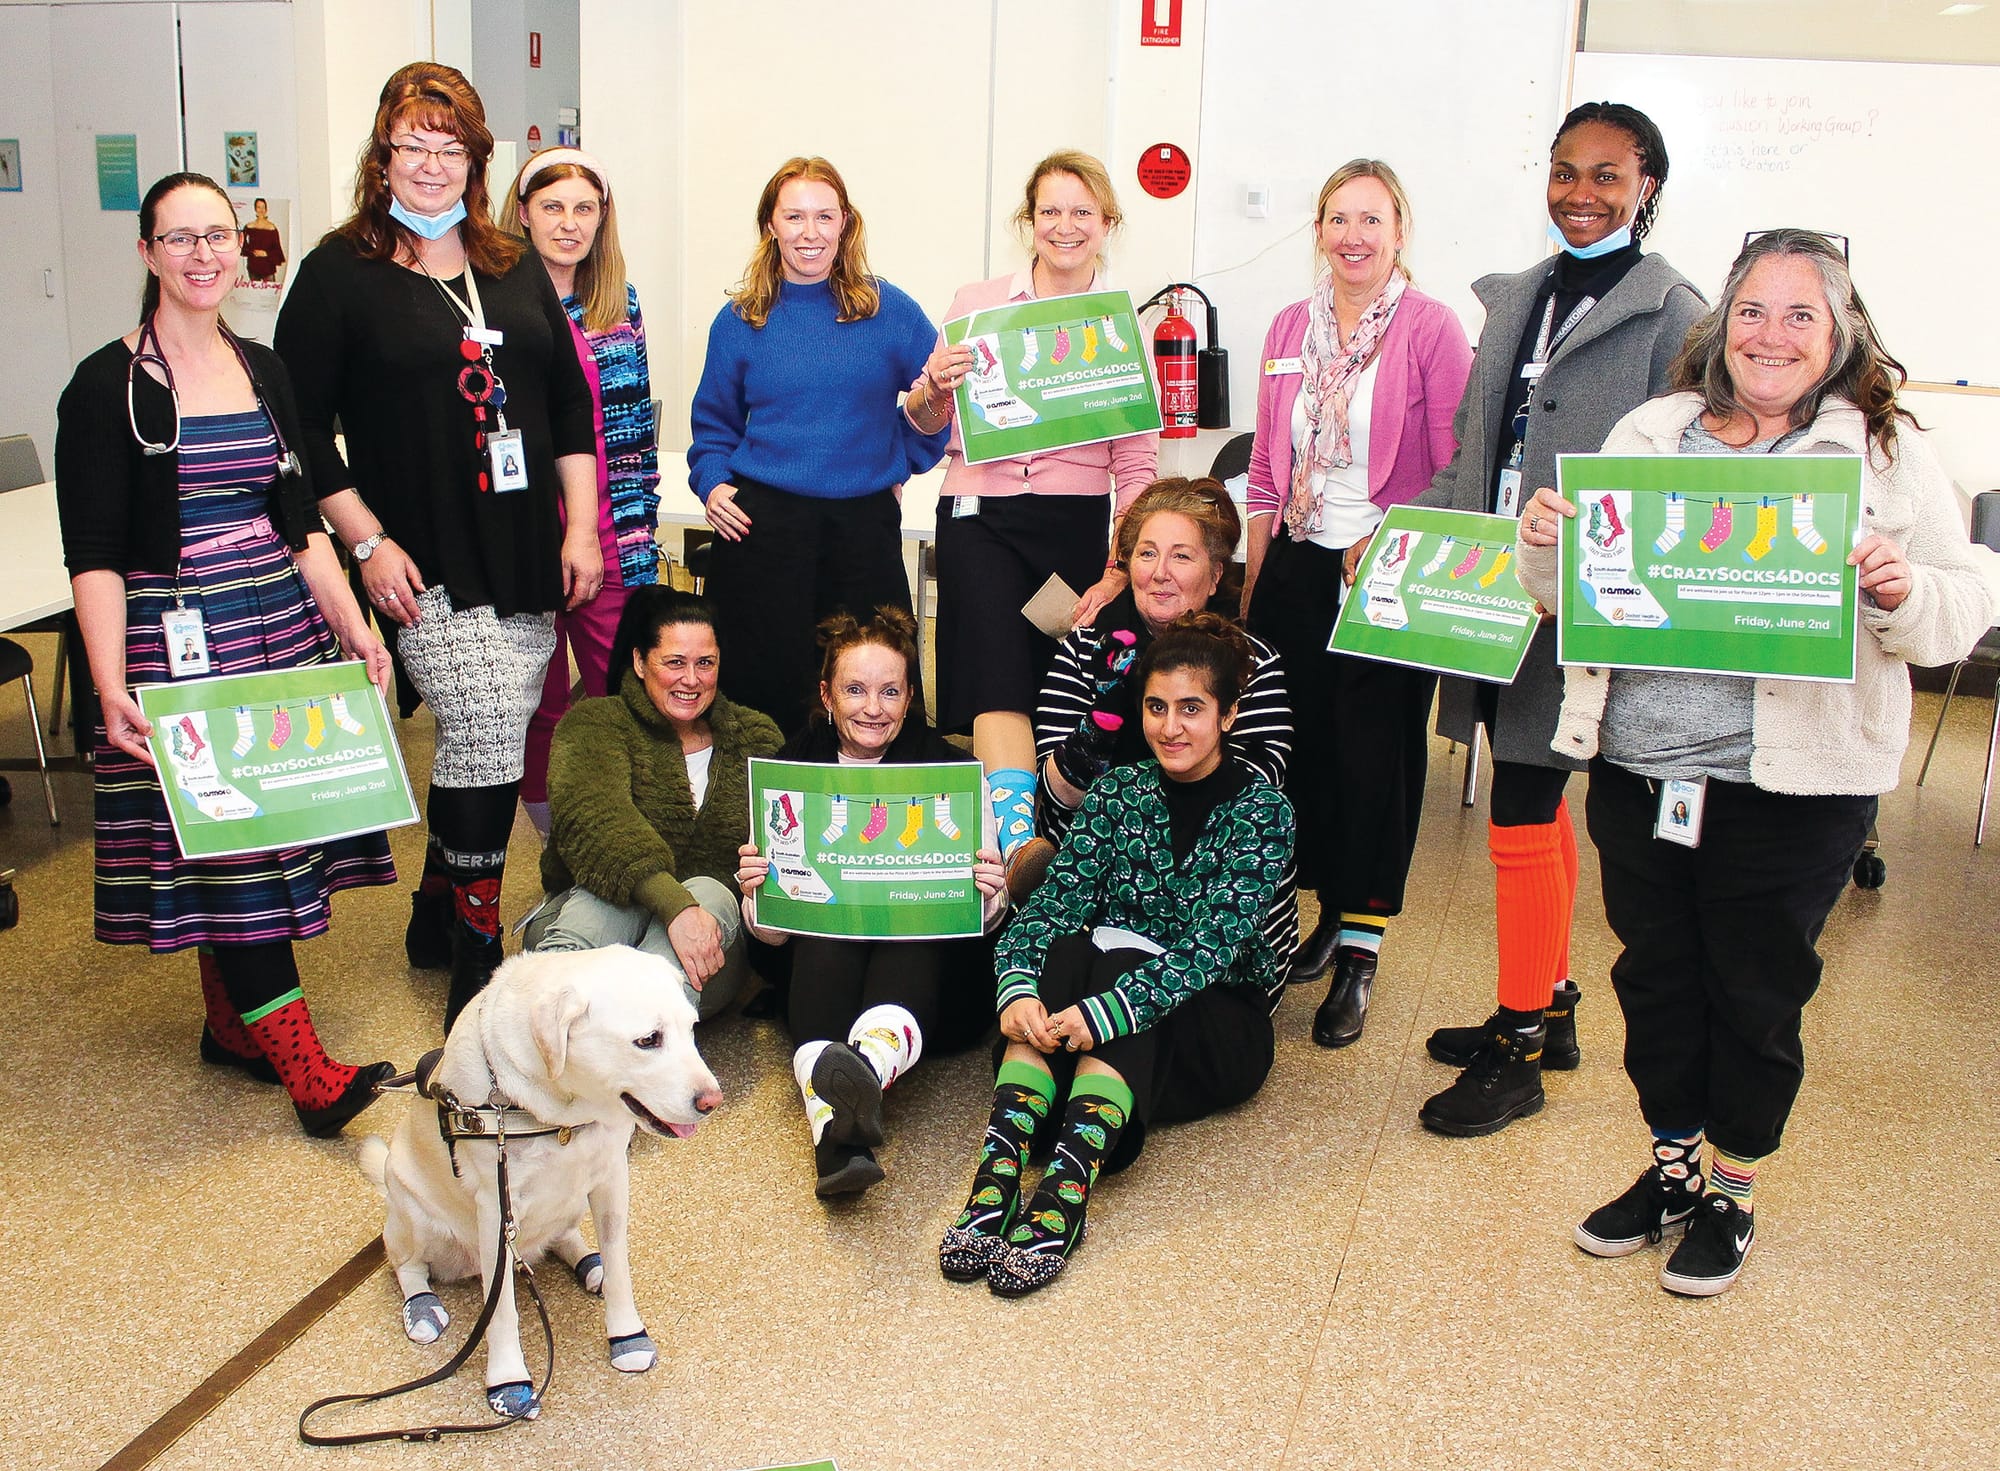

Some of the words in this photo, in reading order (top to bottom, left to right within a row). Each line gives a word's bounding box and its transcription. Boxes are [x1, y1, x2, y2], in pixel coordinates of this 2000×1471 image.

[1142, 36, 1180, 44] EXTINGUISHER
[1153, 28, 1169, 36] FIRE
[1733, 88, 1757, 109] like
[1766, 91, 1777, 109] to
[1782, 94, 1812, 114] join
[1083, 400, 1110, 409] Friday,
[1111, 395, 1128, 405] June
[1128, 392, 1143, 401] 2nd
[1734, 615, 1774, 629] Friday,
[1776, 618, 1806, 629] June
[1807, 619, 1831, 630] 2nd
[1450, 625, 1477, 638] Friday,
[1477, 629, 1498, 640] June
[1498, 632, 1514, 643] 2nd
[311, 790, 345, 801] Friday,
[344, 786, 368, 796] June
[367, 779, 387, 791] 2nd
[889, 891, 922, 902] Friday,
[924, 890, 946, 900] June
[949, 889, 965, 899] 2nd
